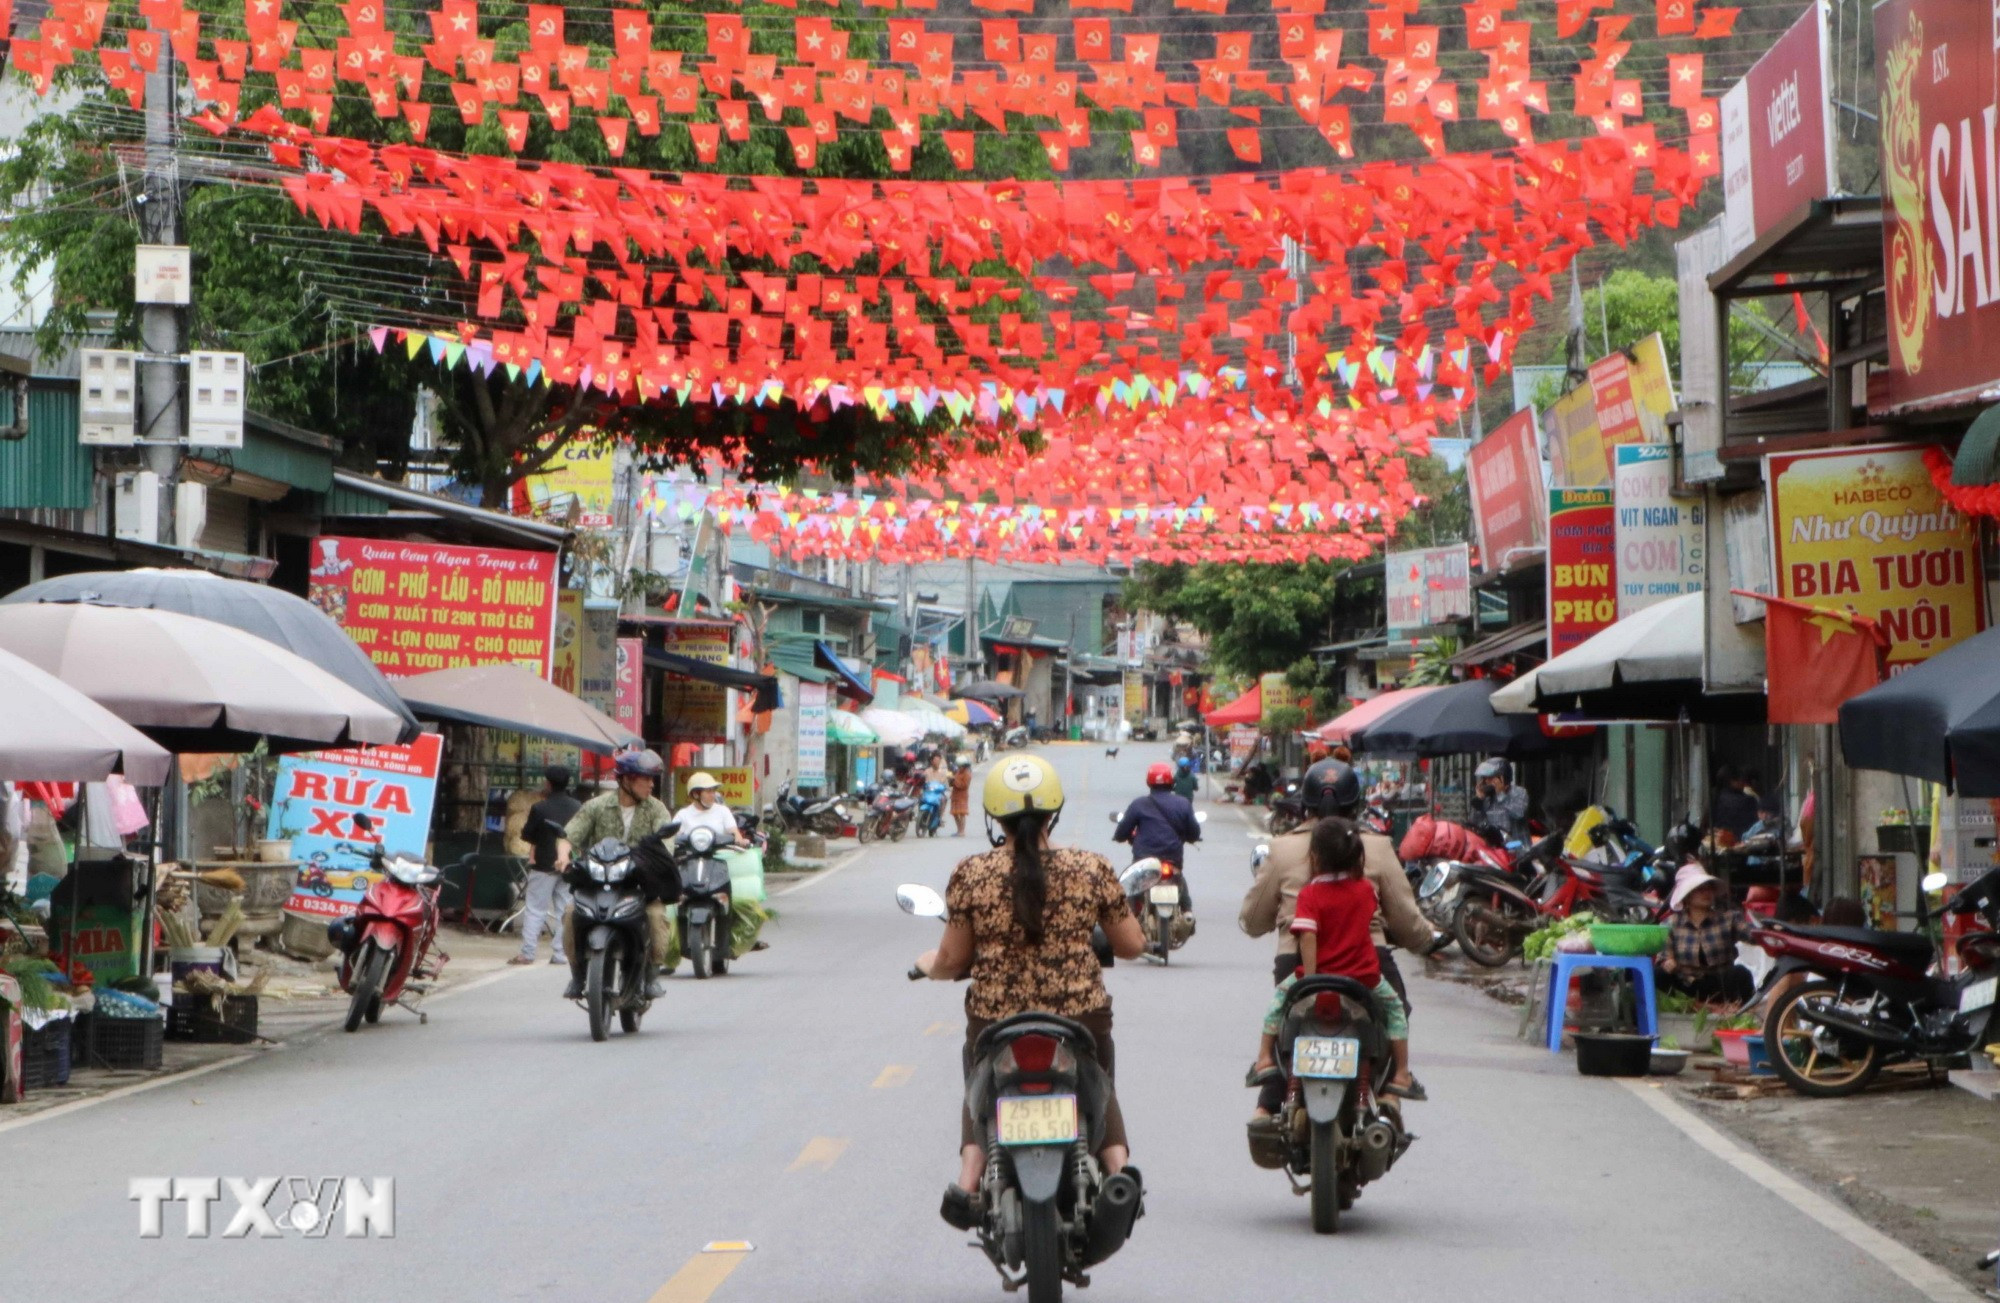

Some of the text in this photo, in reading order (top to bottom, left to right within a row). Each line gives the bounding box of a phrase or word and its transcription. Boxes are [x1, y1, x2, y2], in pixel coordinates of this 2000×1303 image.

[1767, 69, 1801, 148] viettel
[1929, 103, 2000, 319] SAI
[1834, 486, 1912, 505] HABECO
[1621, 507, 1640, 532] VỊT
[1643, 506, 1679, 526] NGAN
[1790, 502, 1960, 544] Như Quỳnh
[362, 545, 395, 561] Quán
[400, 548, 429, 563] Cơm
[433, 550, 471, 566] Ngon
[1554, 558, 1609, 587] BÚN
[1792, 547, 1965, 598] BIA TƯƠI
[352, 567, 386, 596] CƠM
[399, 565, 429, 599] PHỞ
[505, 576, 545, 611] NHẬU
[359, 603, 390, 620] CƠM
[394, 602, 428, 622] XUẤT
[451, 609, 476, 626] 29K
[509, 613, 534, 629] LÊN
[1554, 592, 1616, 623] PHỞ
[1881, 598, 1951, 649] NỘI
[372, 650, 400, 666] BIA
[405, 651, 444, 669] TƯƠI
[425, 631, 461, 650] QUAY
[475, 634, 504, 653] CHÓ
[508, 638, 543, 656] QUAY
[289, 768, 412, 815] RỬA
[307, 807, 385, 844] XE
